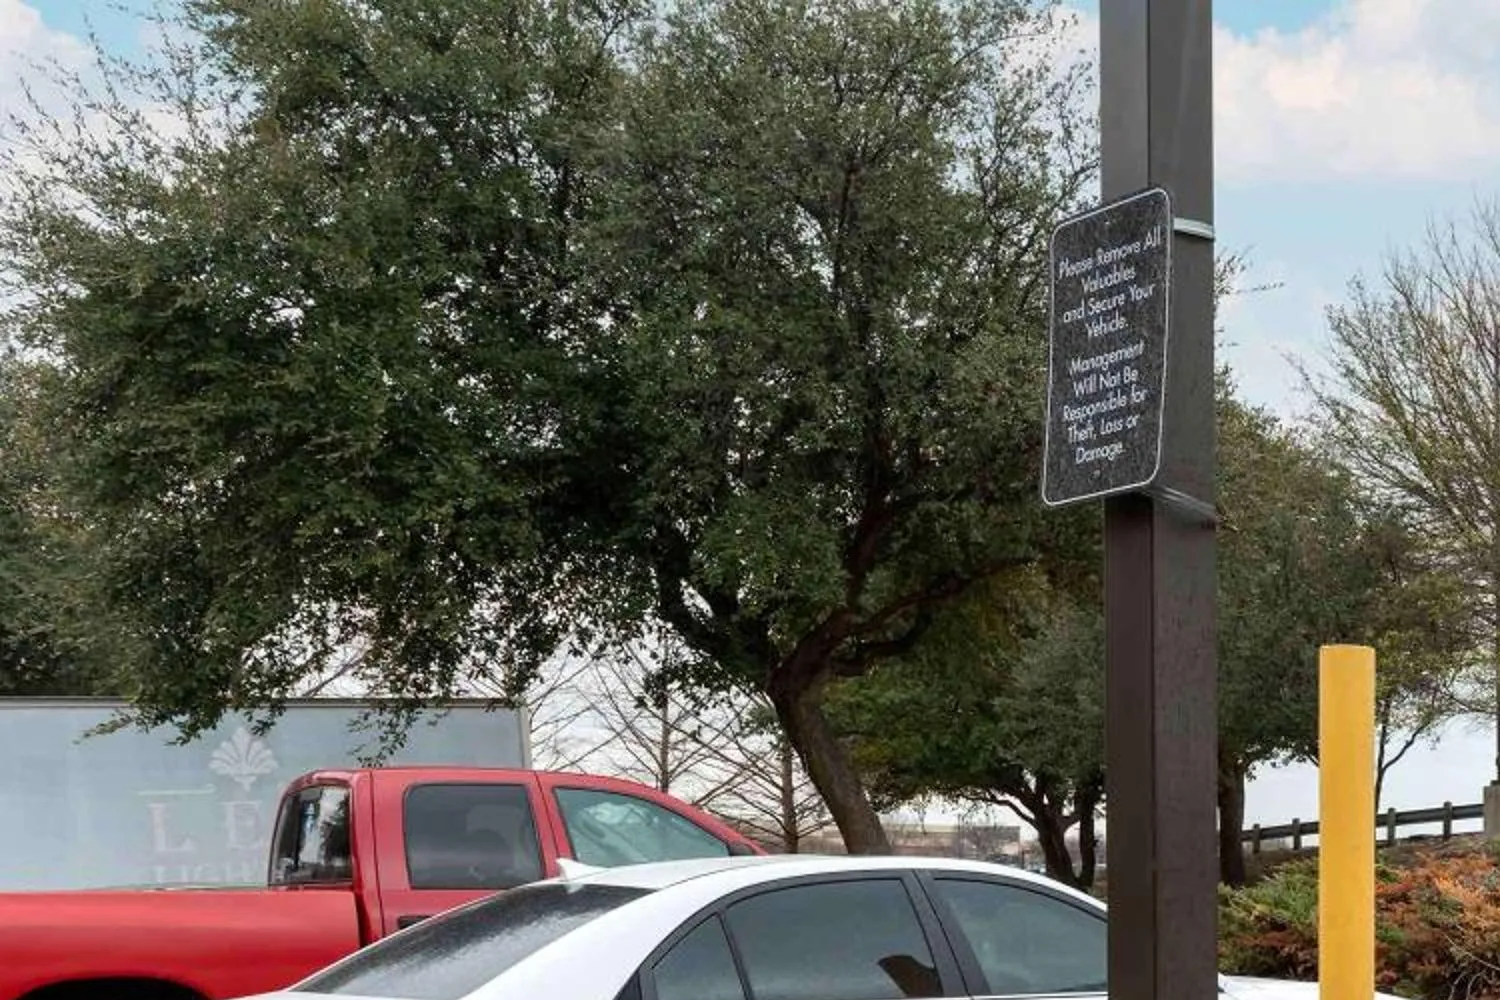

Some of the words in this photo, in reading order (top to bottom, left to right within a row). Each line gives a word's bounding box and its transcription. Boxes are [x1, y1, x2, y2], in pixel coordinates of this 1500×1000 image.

[1059, 257, 1093, 280] Please
[1097, 241, 1140, 265] Remove
[1143, 225, 1161, 250] All
[1081, 263, 1136, 293] Valuables
[1063, 298, 1085, 323] and
[1088, 292, 1125, 315] Secure
[1129, 283, 1156, 302] Your
[1069, 339, 1144, 375] Management
[1074, 373, 1097, 397] Will
[1100, 370, 1121, 389] Not
[1124, 365, 1138, 383] Be
[1064, 389, 1127, 421] Responsible
[1131, 384, 1147, 403] for
[1100, 418, 1123, 435] Loss
[1125, 414, 1140, 429] or
